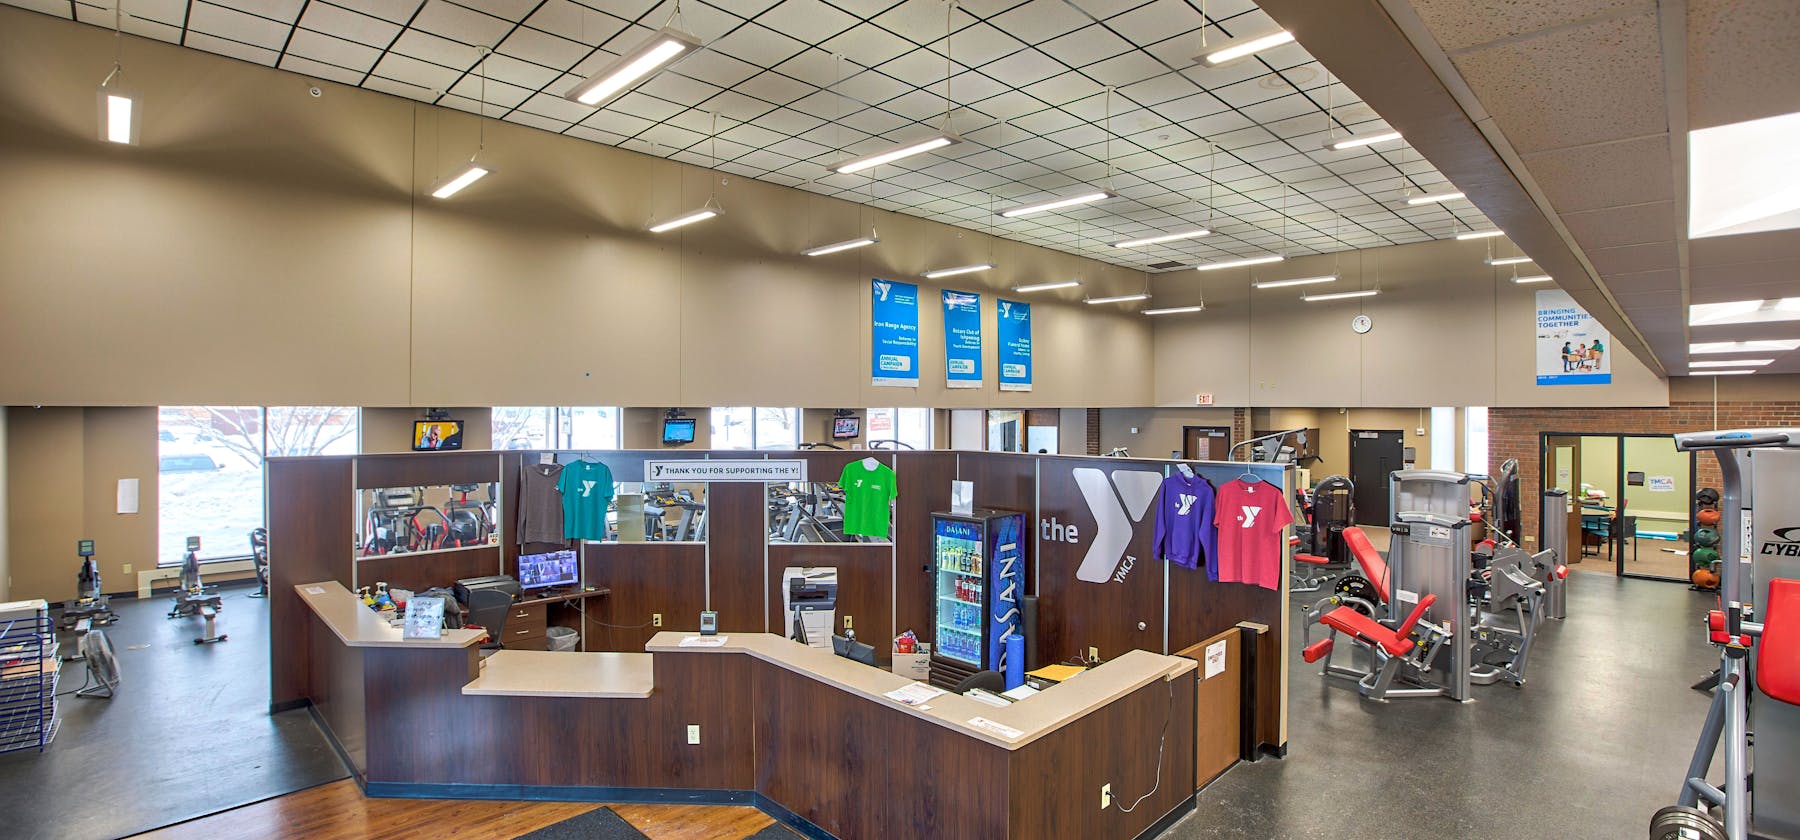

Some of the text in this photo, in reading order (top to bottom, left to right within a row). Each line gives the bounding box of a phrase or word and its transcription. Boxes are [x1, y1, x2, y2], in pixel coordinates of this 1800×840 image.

[1538, 308, 1575, 316] BRINGING
[900, 323, 916, 332] Agency
[1538, 320, 1579, 328] TOGETHER
[946, 525, 970, 536] DASANI
[1041, 467, 1163, 584] the Y
[1761, 543, 1800, 557] CYB
[1113, 555, 1137, 584] YMCA
